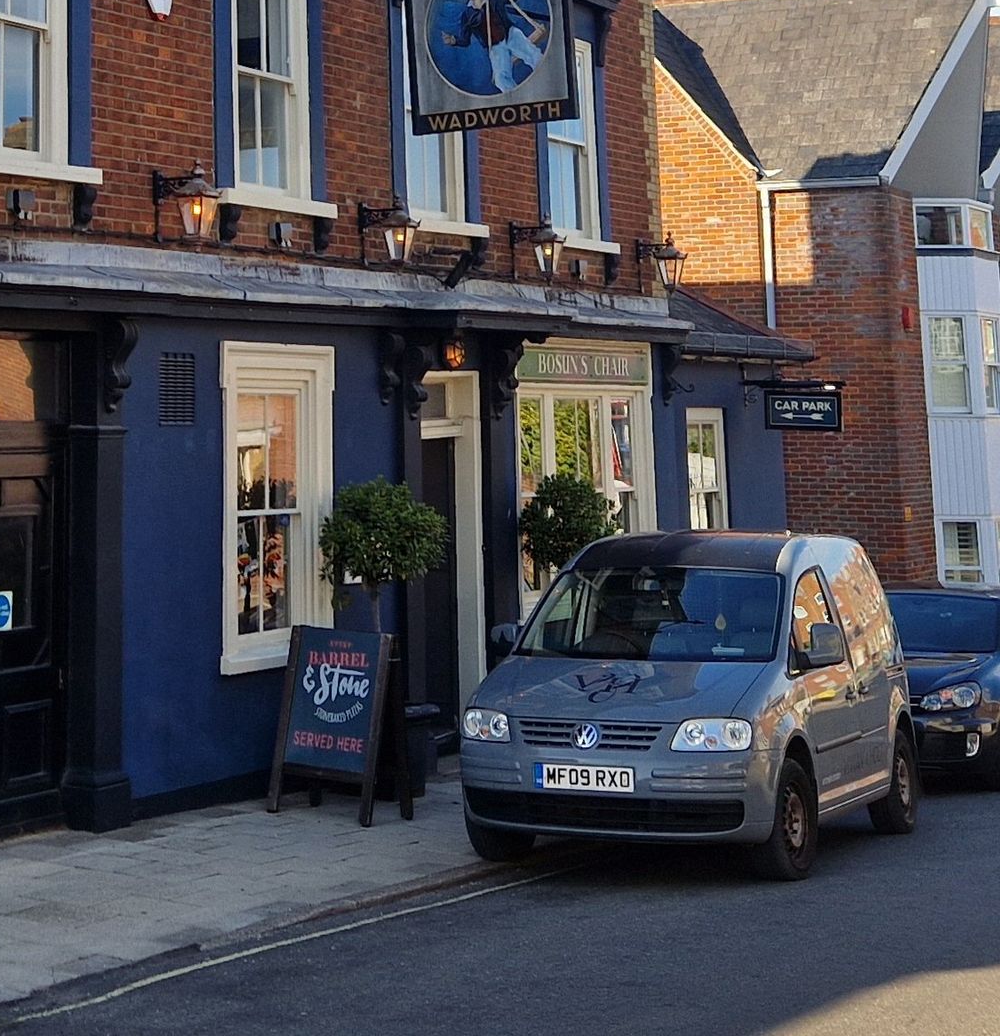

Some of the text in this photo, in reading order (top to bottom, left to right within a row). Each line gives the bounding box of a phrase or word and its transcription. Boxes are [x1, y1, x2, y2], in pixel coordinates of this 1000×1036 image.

[429, 101, 561, 132] WADWORTH
[594, 356, 630, 376] CHAIR
[774, 400, 832, 412] CAR PARK
[308, 650, 369, 667] BARREL
[313, 662, 370, 705] Stone
[293, 730, 364, 753] SERVED HERE
[546, 767, 630, 787] MF09 RXO
